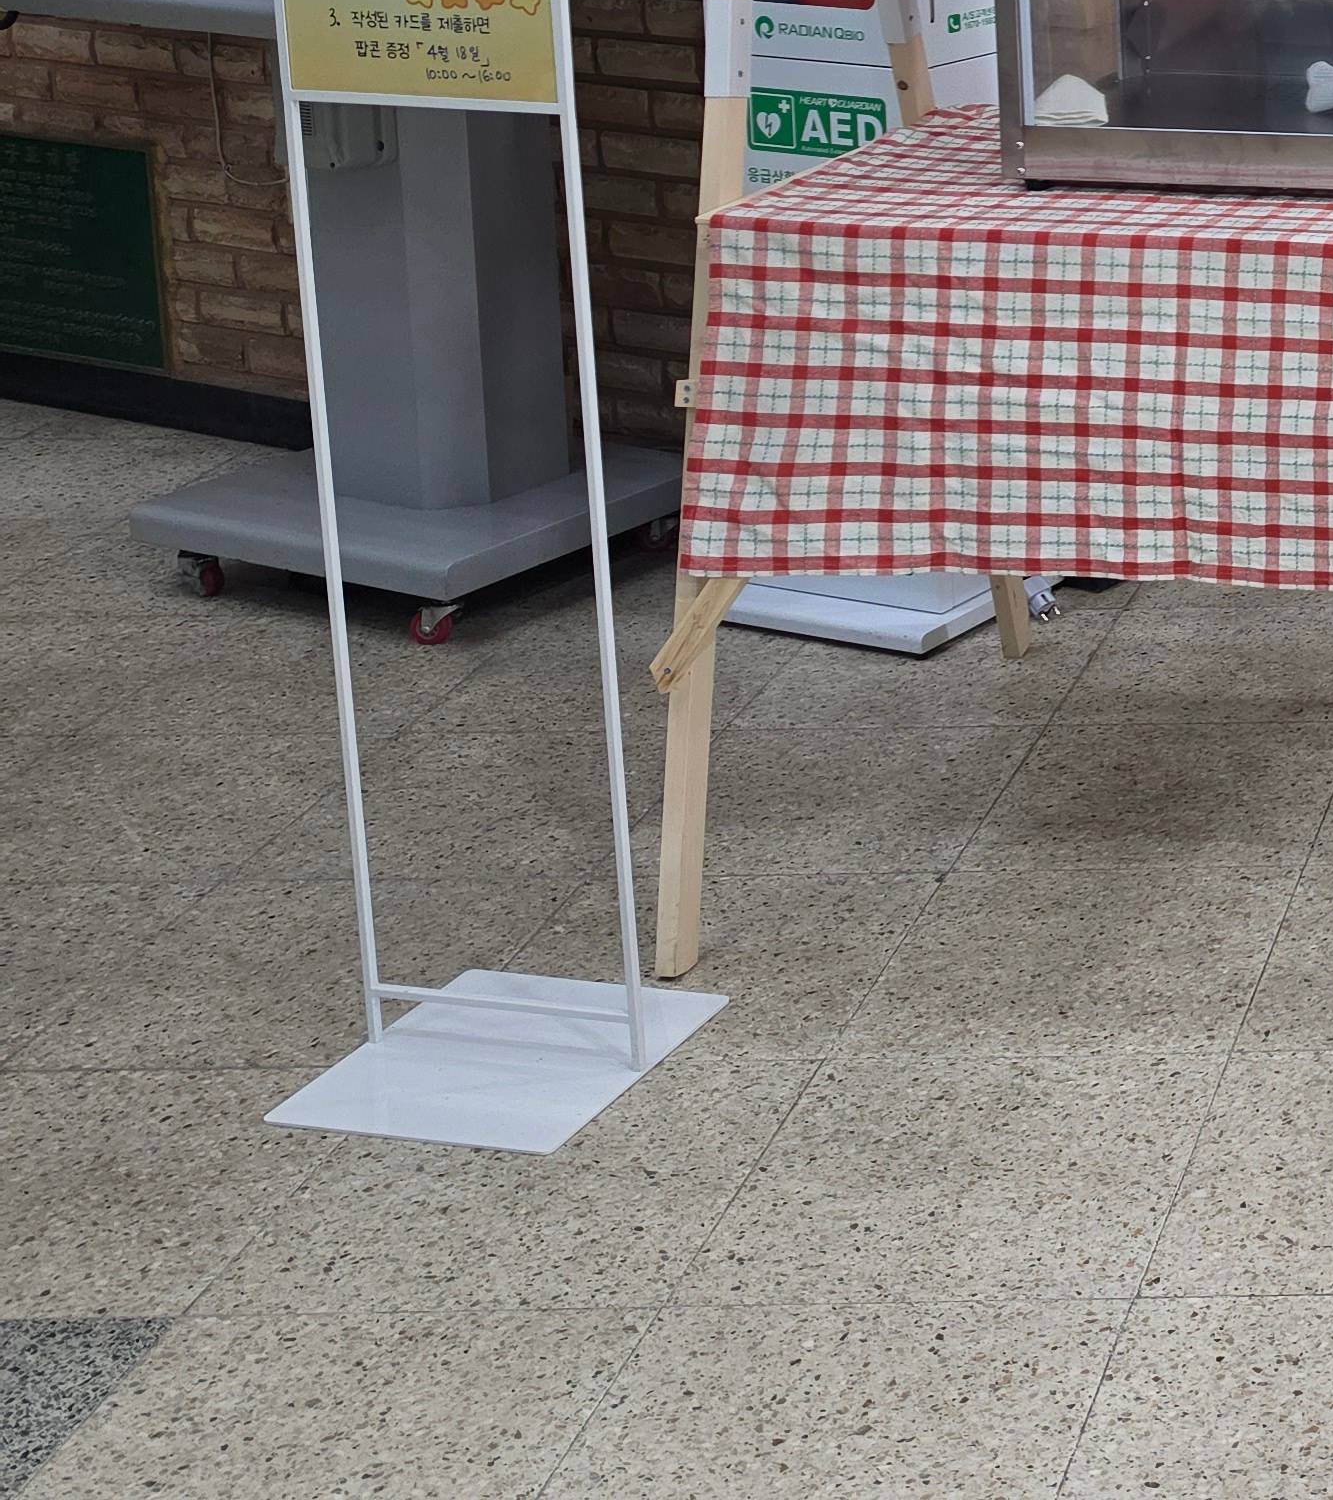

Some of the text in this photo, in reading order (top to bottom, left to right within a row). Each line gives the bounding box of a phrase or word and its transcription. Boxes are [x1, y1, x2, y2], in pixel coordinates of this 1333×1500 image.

[329, 7, 491, 34] 3. 작성된 카드를 제출하면
[354, 40, 381, 58] 팝콘
[386, 42, 410, 59] 증정
[801, 109, 883, 148] AED
